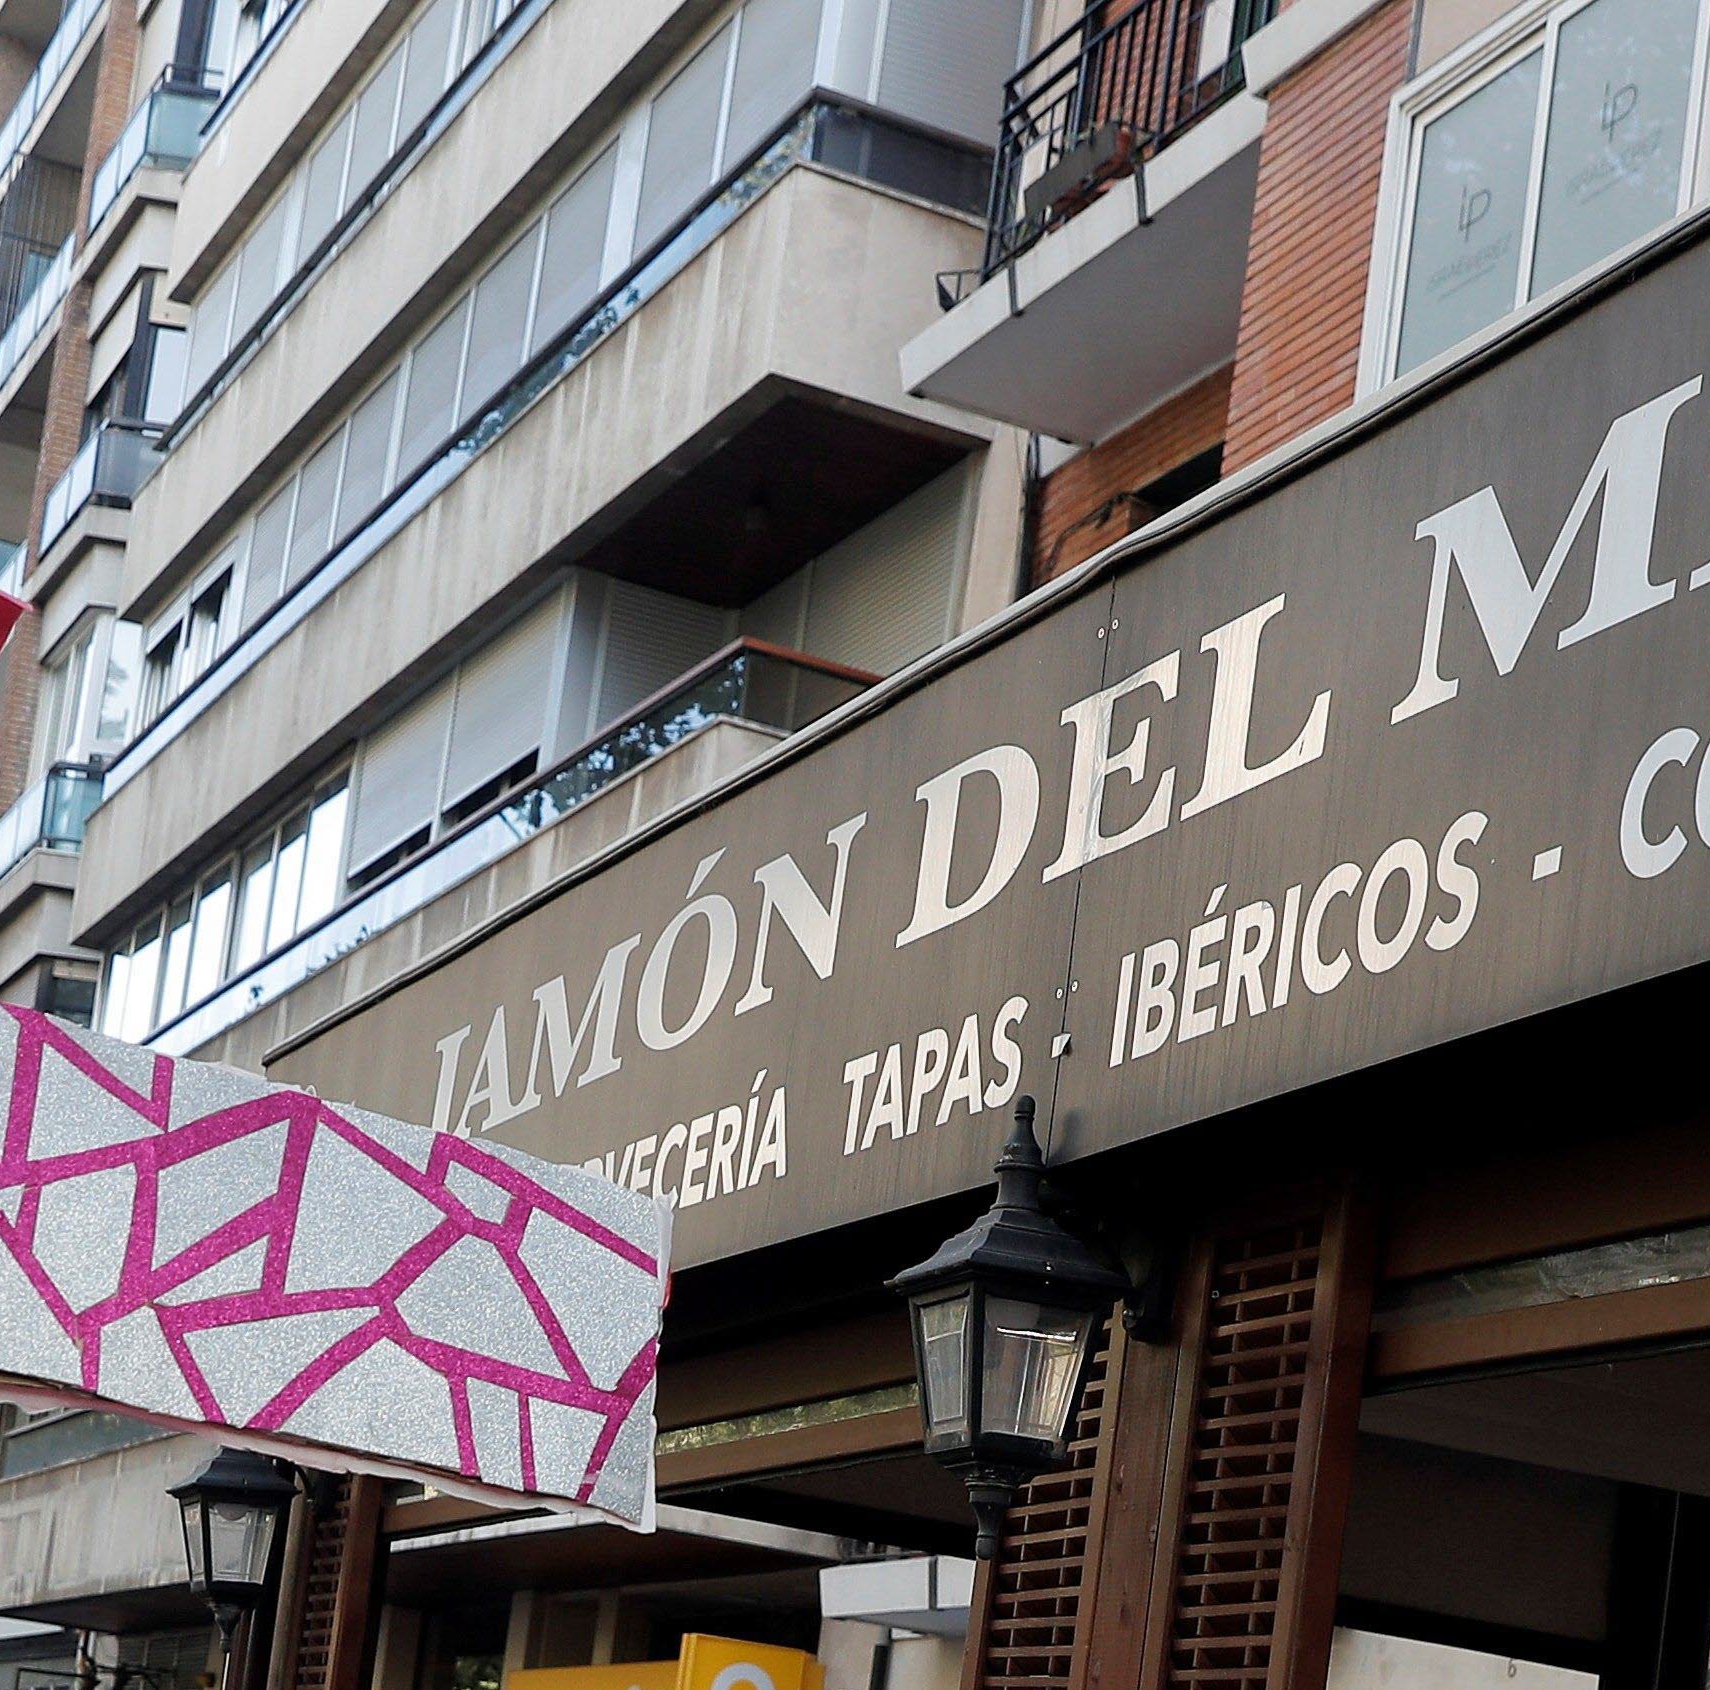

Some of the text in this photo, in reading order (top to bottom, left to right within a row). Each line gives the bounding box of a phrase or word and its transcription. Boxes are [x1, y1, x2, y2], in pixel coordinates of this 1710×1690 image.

[431, 813, 866, 1137] JAMÓN
[896, 593, 1333, 948] DEL
[844, 996, 1028, 1154] TAPAS
[1110, 811, 1490, 1067] IBÉRICOS
